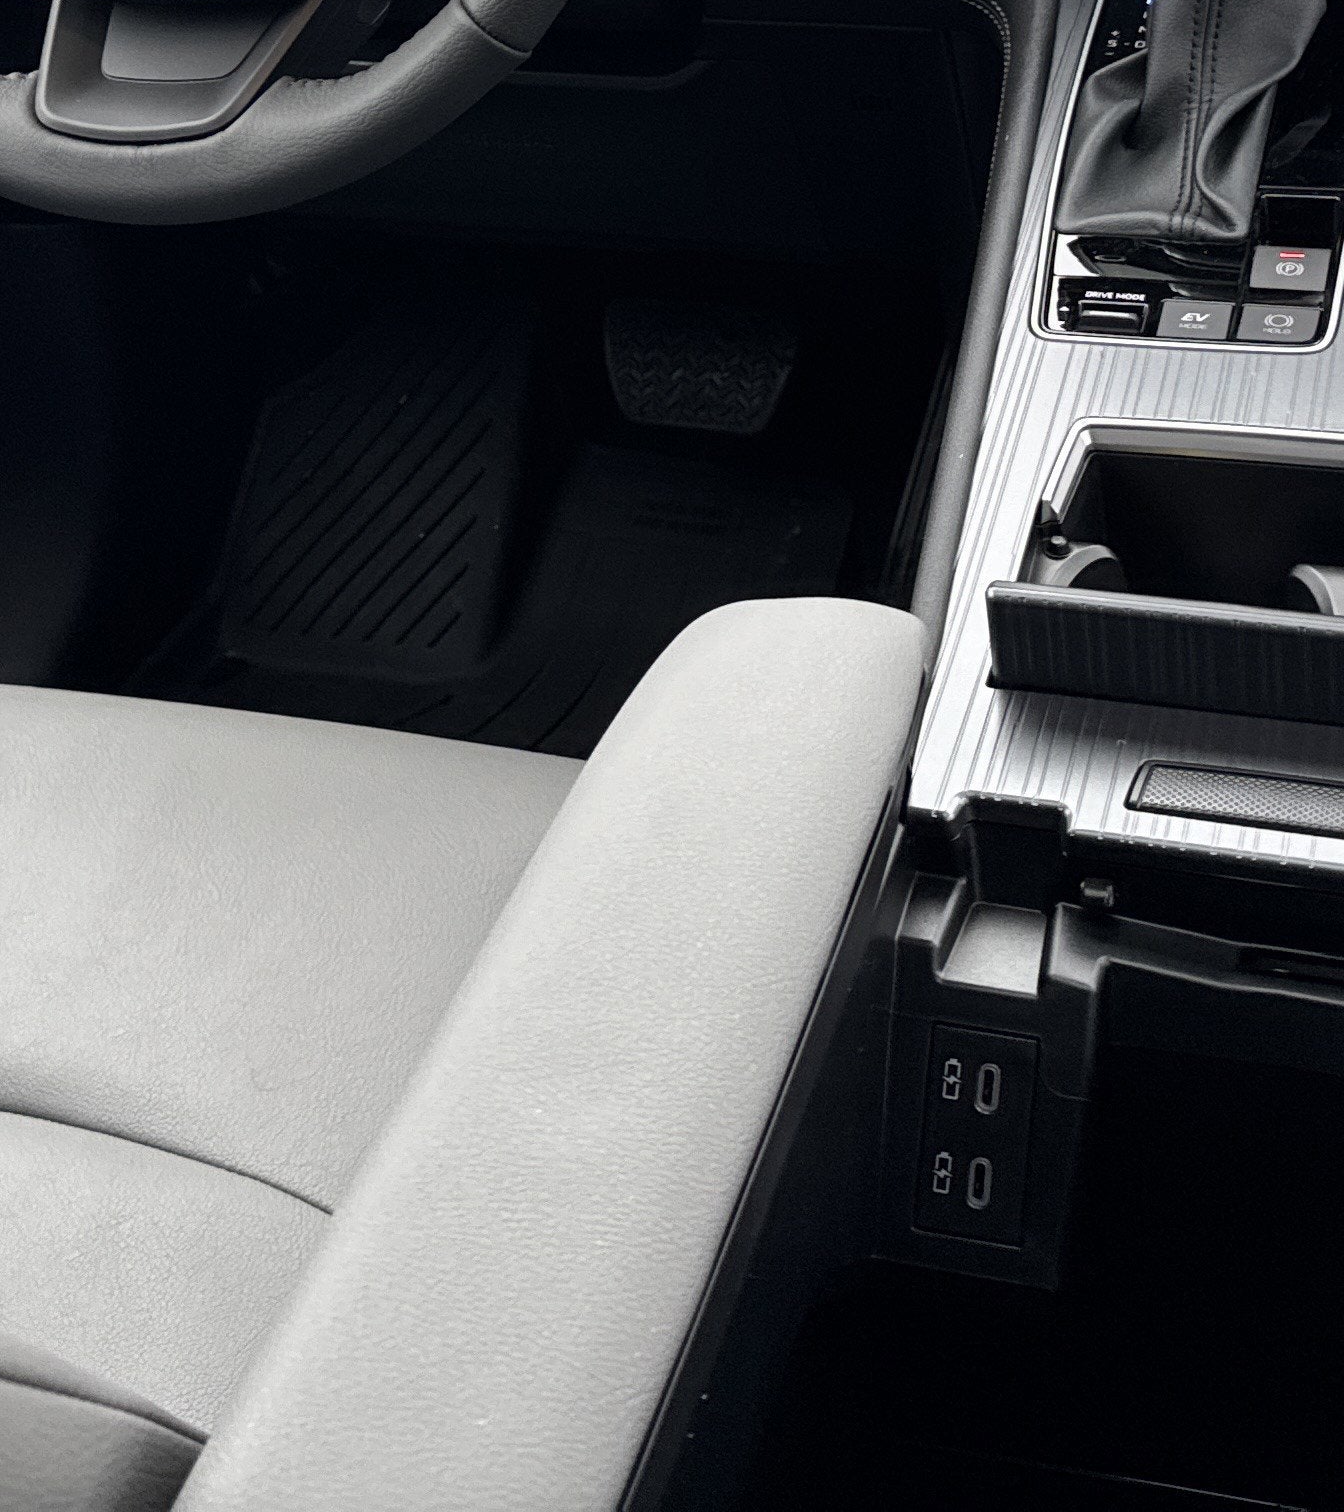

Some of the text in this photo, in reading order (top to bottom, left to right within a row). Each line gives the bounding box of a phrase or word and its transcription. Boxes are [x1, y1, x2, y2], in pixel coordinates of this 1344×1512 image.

[1084, 290, 1146, 302] DRIVE MODE
[1180, 312, 1211, 322] EV
